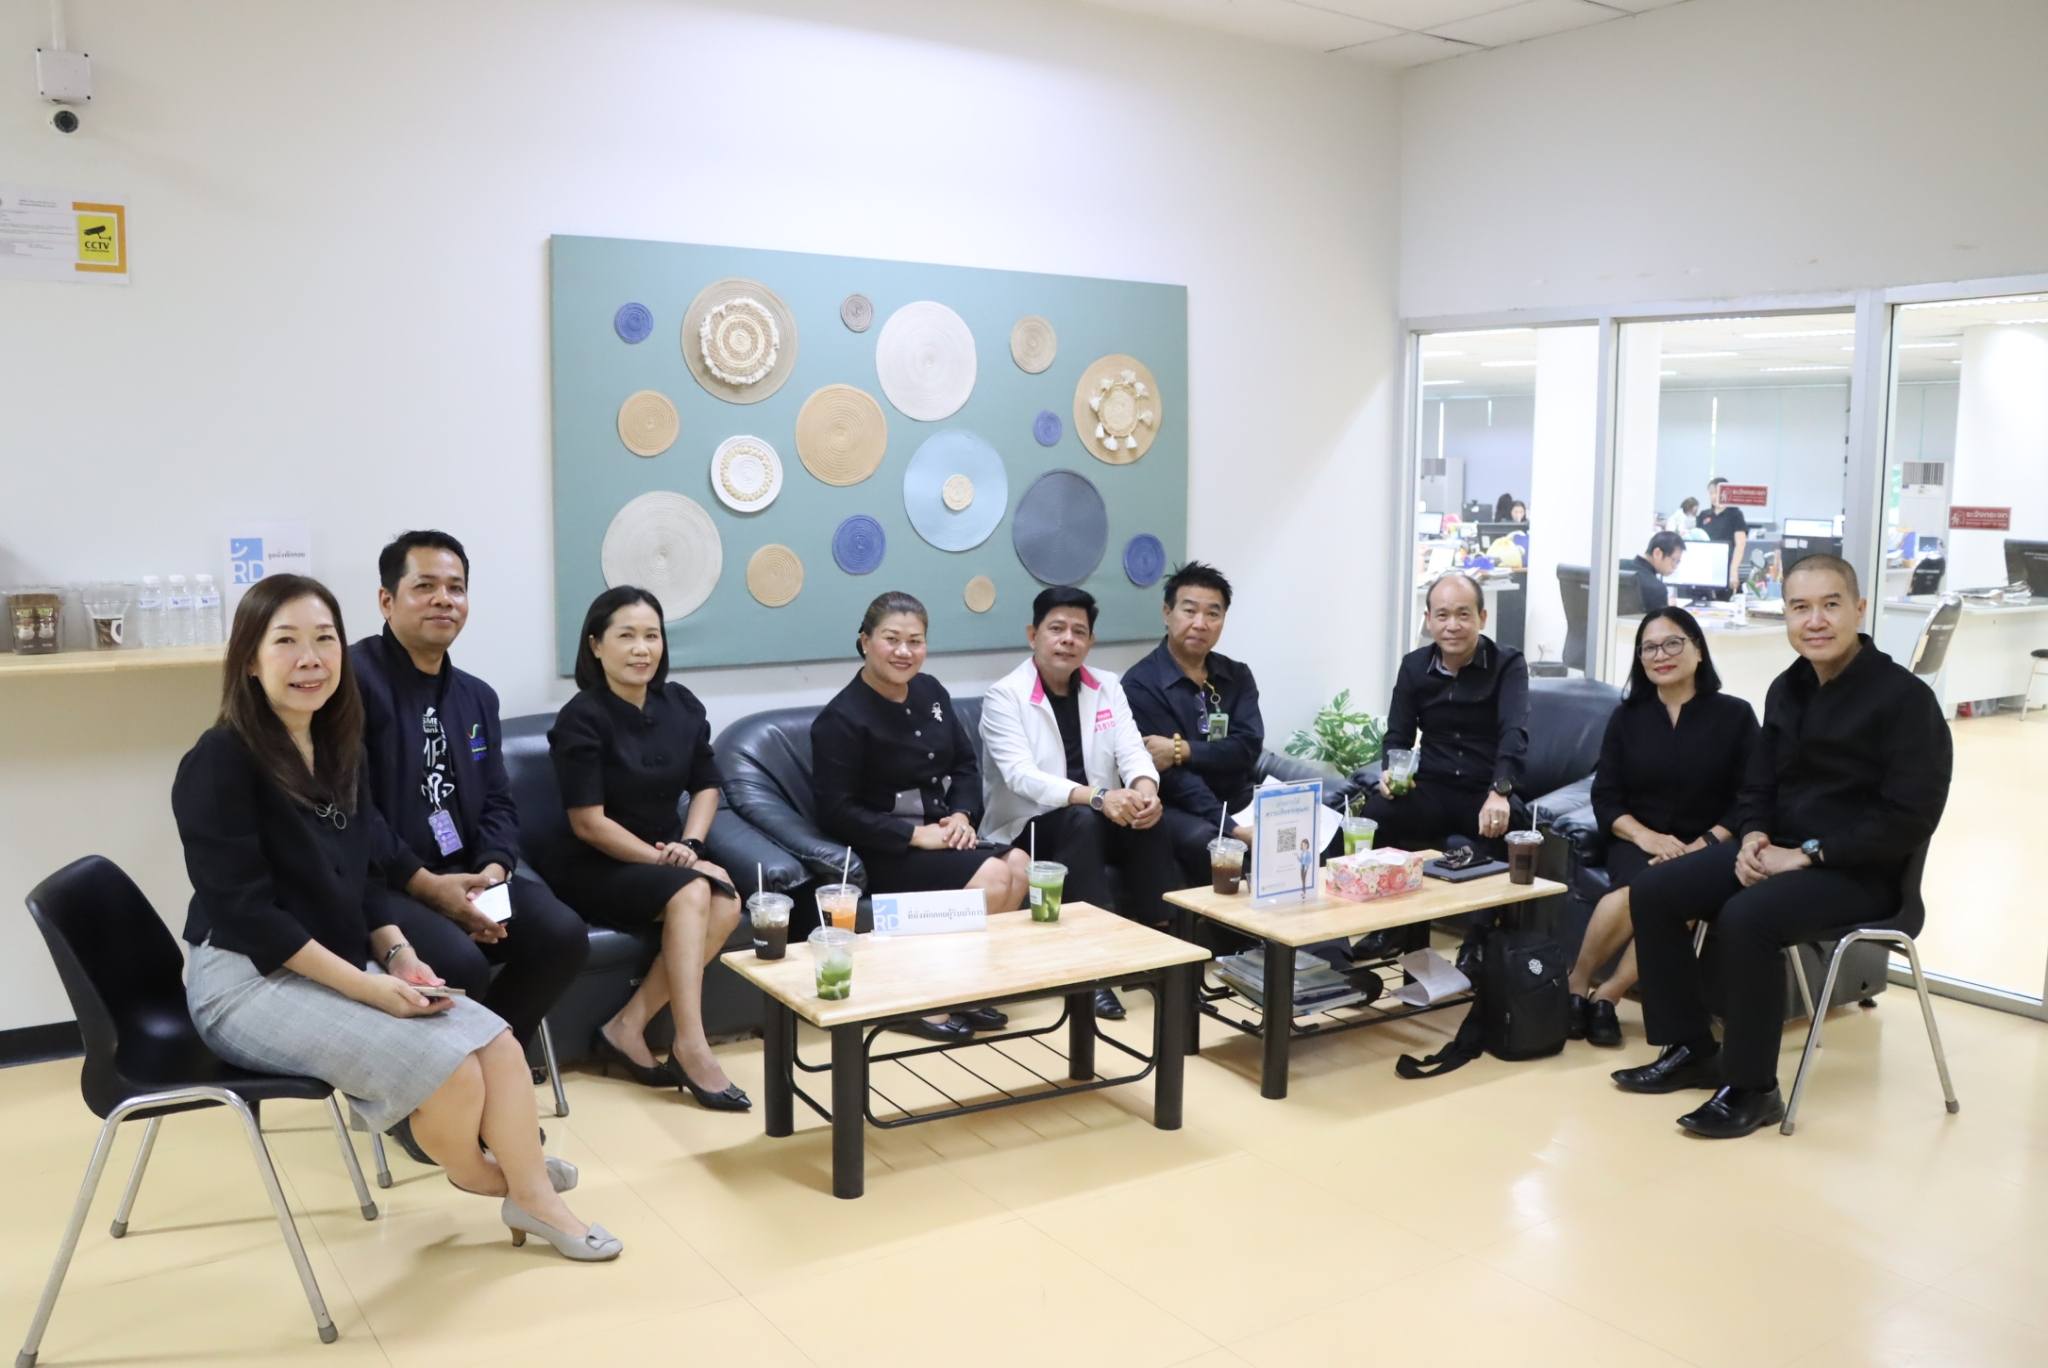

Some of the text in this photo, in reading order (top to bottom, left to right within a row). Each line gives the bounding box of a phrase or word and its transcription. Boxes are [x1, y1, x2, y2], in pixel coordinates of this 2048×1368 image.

[84, 241, 110, 250] CCTV
[233, 560, 265, 583] RD
[874, 914, 899, 932] RD
